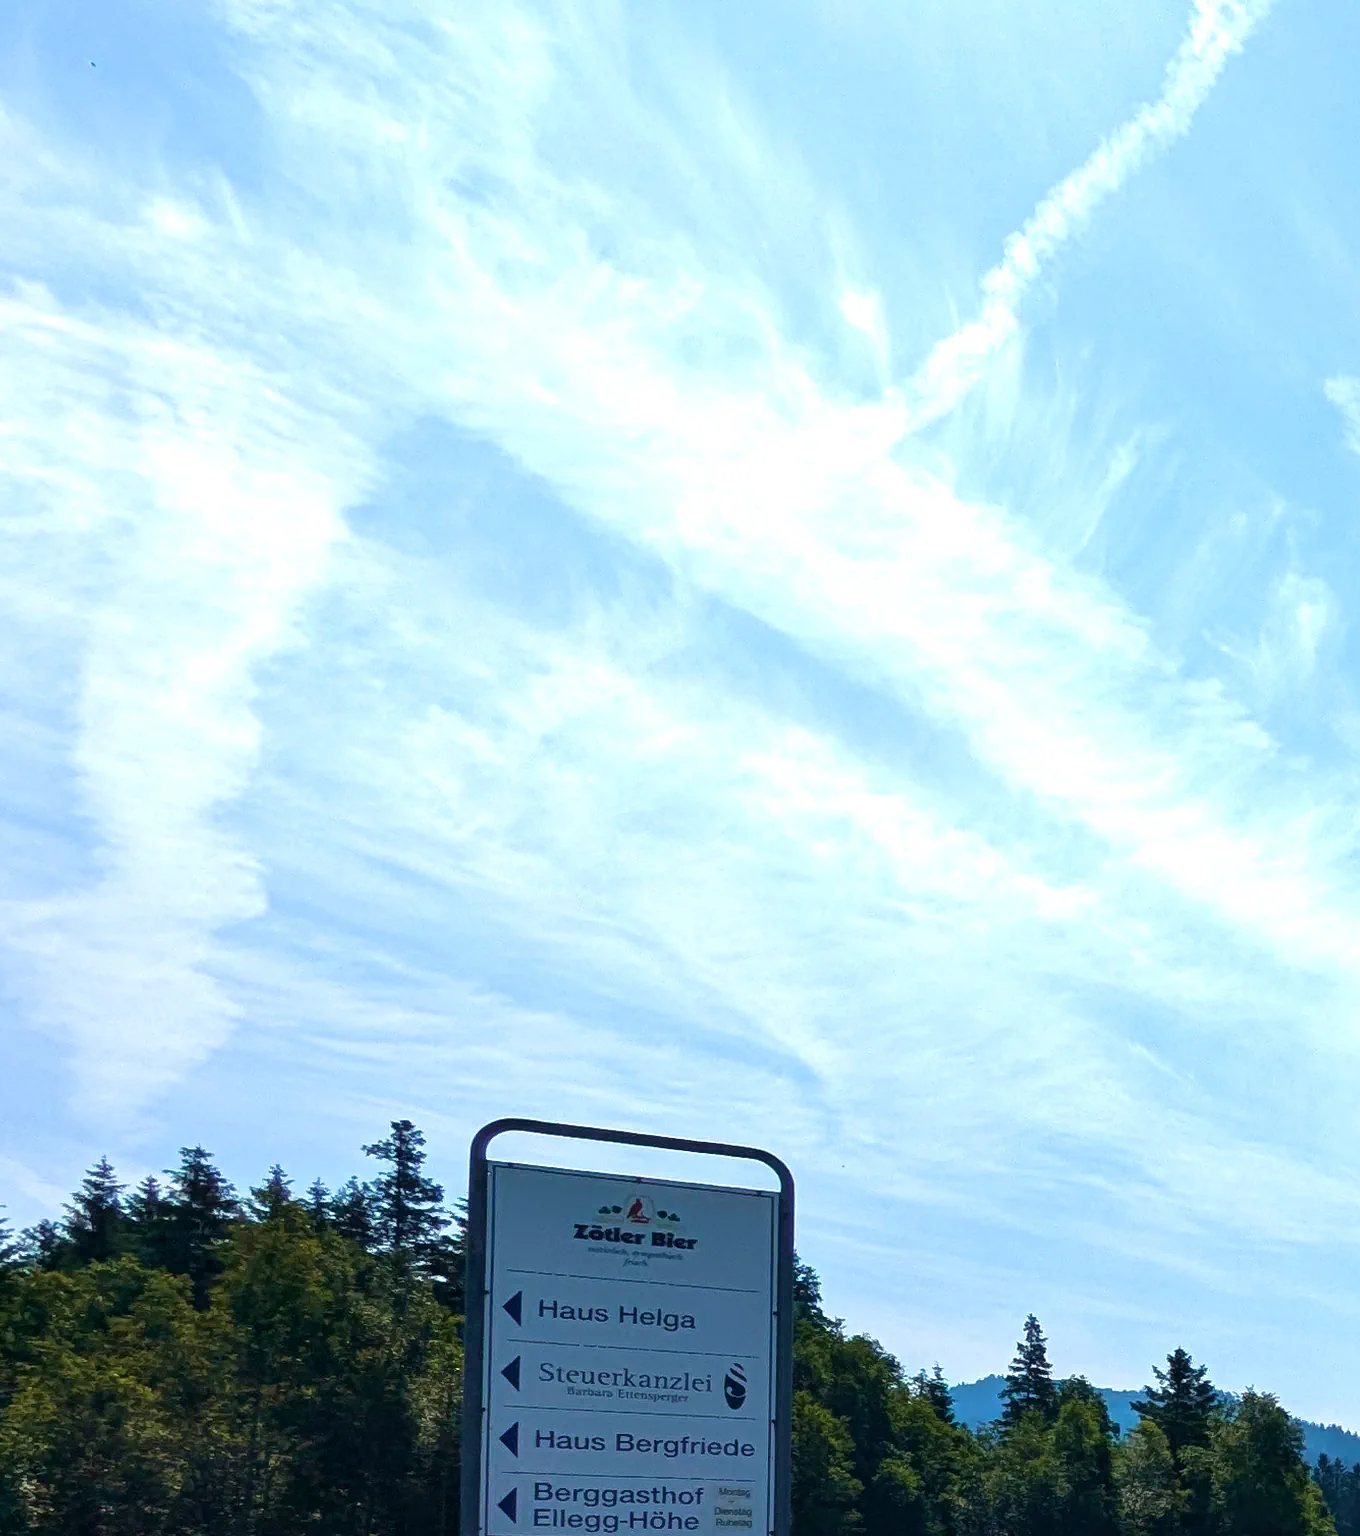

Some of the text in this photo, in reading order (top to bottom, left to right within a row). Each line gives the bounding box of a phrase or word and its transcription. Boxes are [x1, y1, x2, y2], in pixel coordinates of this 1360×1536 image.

[573, 1223, 699, 1250] Zötler Bier
[538, 1299, 696, 1332] Haus Helga
[538, 1362, 713, 1393] Steuerkanzlei
[566, 1386, 613, 1399] Barbara
[535, 1429, 756, 1458] Haus Bergfriede
[533, 1481, 704, 1507] Berggasthof
[533, 1508, 700, 1533] Ellegg-Höhe
[714, 1506, 753, 1518] Dienstag
